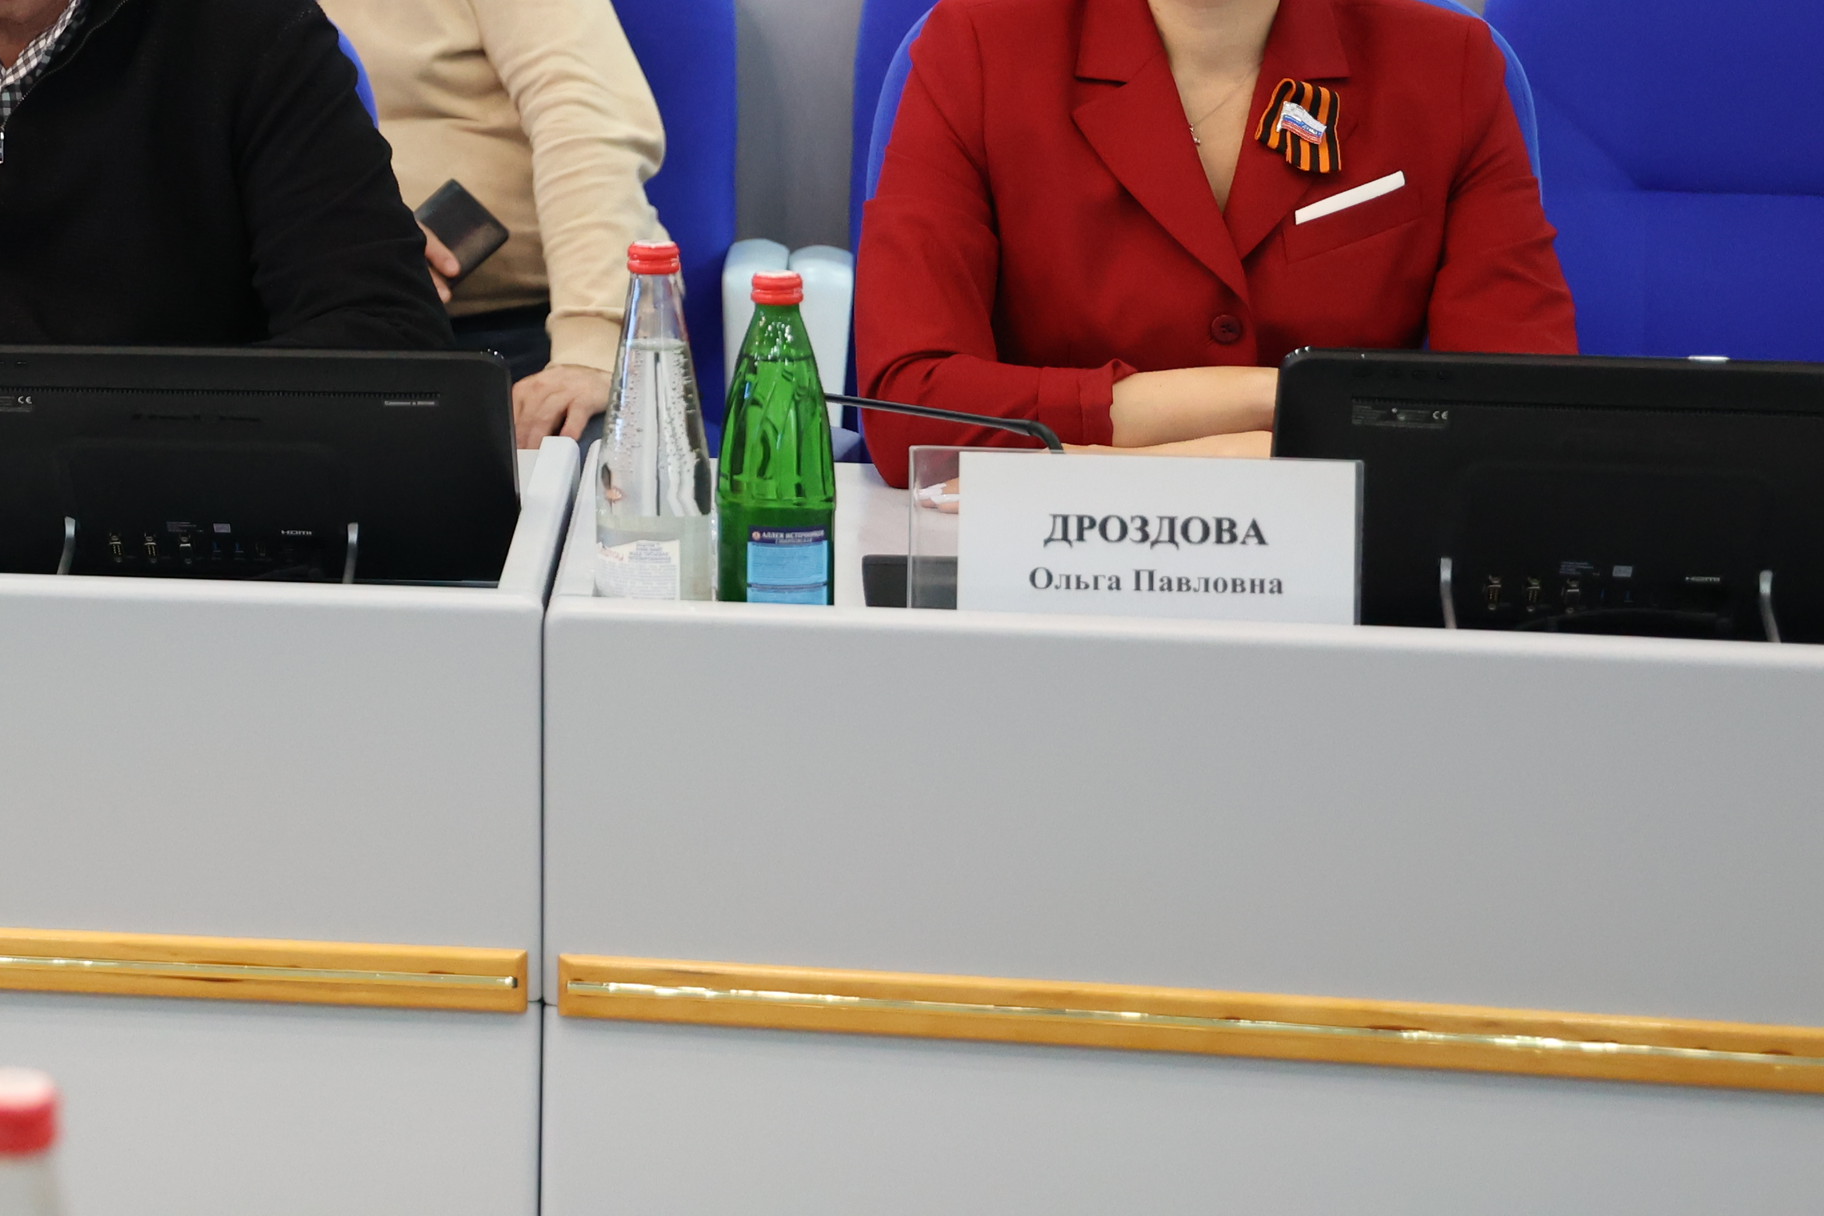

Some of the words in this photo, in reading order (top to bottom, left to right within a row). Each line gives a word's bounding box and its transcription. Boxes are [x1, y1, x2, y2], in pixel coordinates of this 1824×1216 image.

[1043, 513, 1269, 550] ДРОЗДОВА
[1028, 567, 1122, 592] Ольга
[1133, 569, 1284, 595] Павловна
